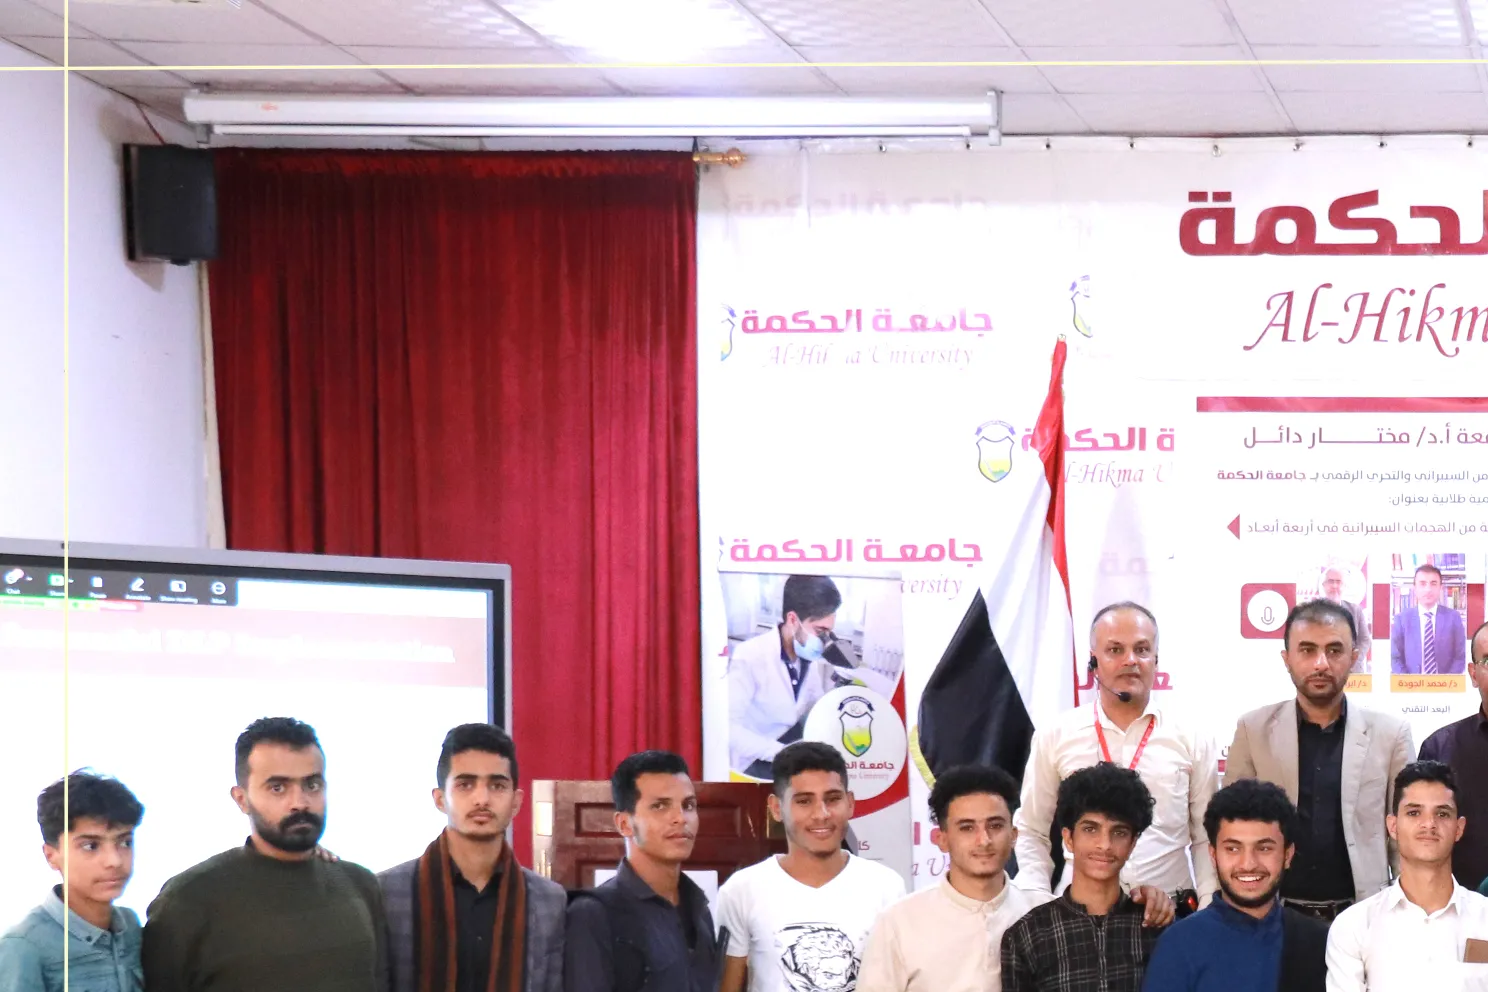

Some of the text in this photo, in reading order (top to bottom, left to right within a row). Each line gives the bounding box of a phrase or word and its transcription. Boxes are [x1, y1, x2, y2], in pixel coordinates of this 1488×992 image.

[741, 307, 994, 337] جامعة الحكمة
[1244, 425, 1302, 449] دائل
[1308, 427, 1410, 448] مختار
[1064, 461, 1144, 488] l-Hikma
[1217, 469, 1263, 480] الحكمة
[1266, 469, 1306, 482] جامعة
[1342, 521, 1400, 536] السيبرانية
[1404, 521, 1455, 535] الهجمات
[1459, 524, 1476, 535] من
[730, 537, 983, 568] جامعة الحكمة
[900, 574, 962, 600] versity
